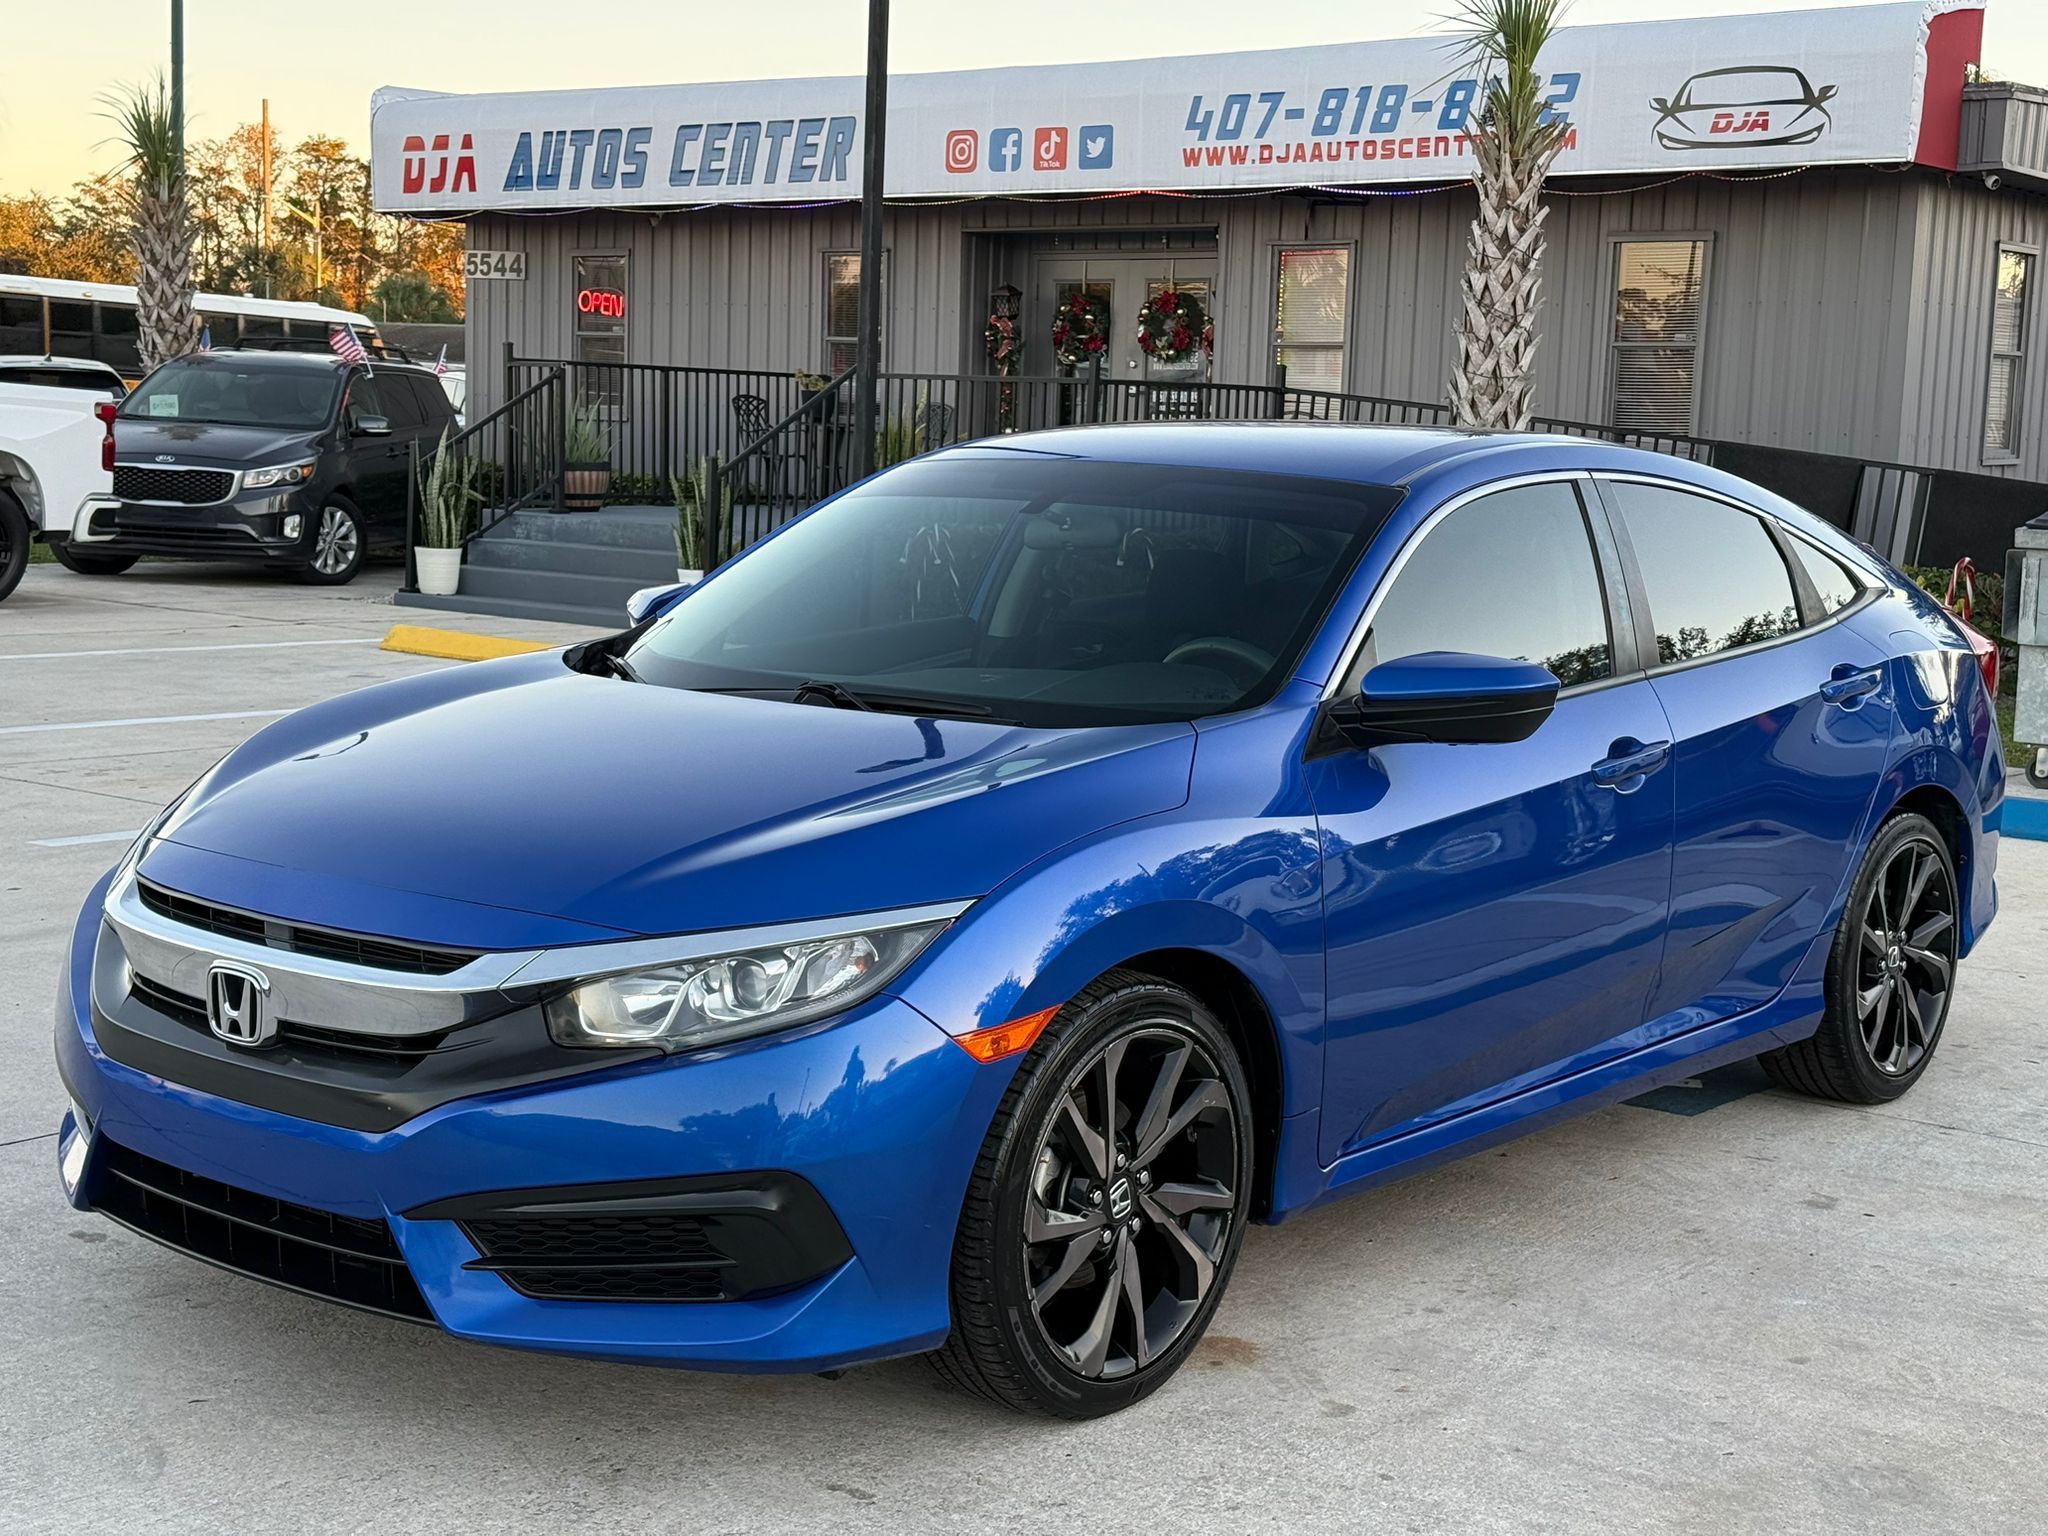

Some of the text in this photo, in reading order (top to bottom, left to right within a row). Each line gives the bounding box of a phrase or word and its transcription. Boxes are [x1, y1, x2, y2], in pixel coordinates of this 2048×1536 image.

[1184, 72, 1582, 142] 407-818-82
[1709, 111, 1770, 134] DJA
[402, 116, 857, 194] DJA AUTOS CENTER
[1182, 128, 1577, 168] WWW.DJAAUTOSCENTM
[466, 252, 523, 277] 5544
[578, 289, 625, 318] OPEN
